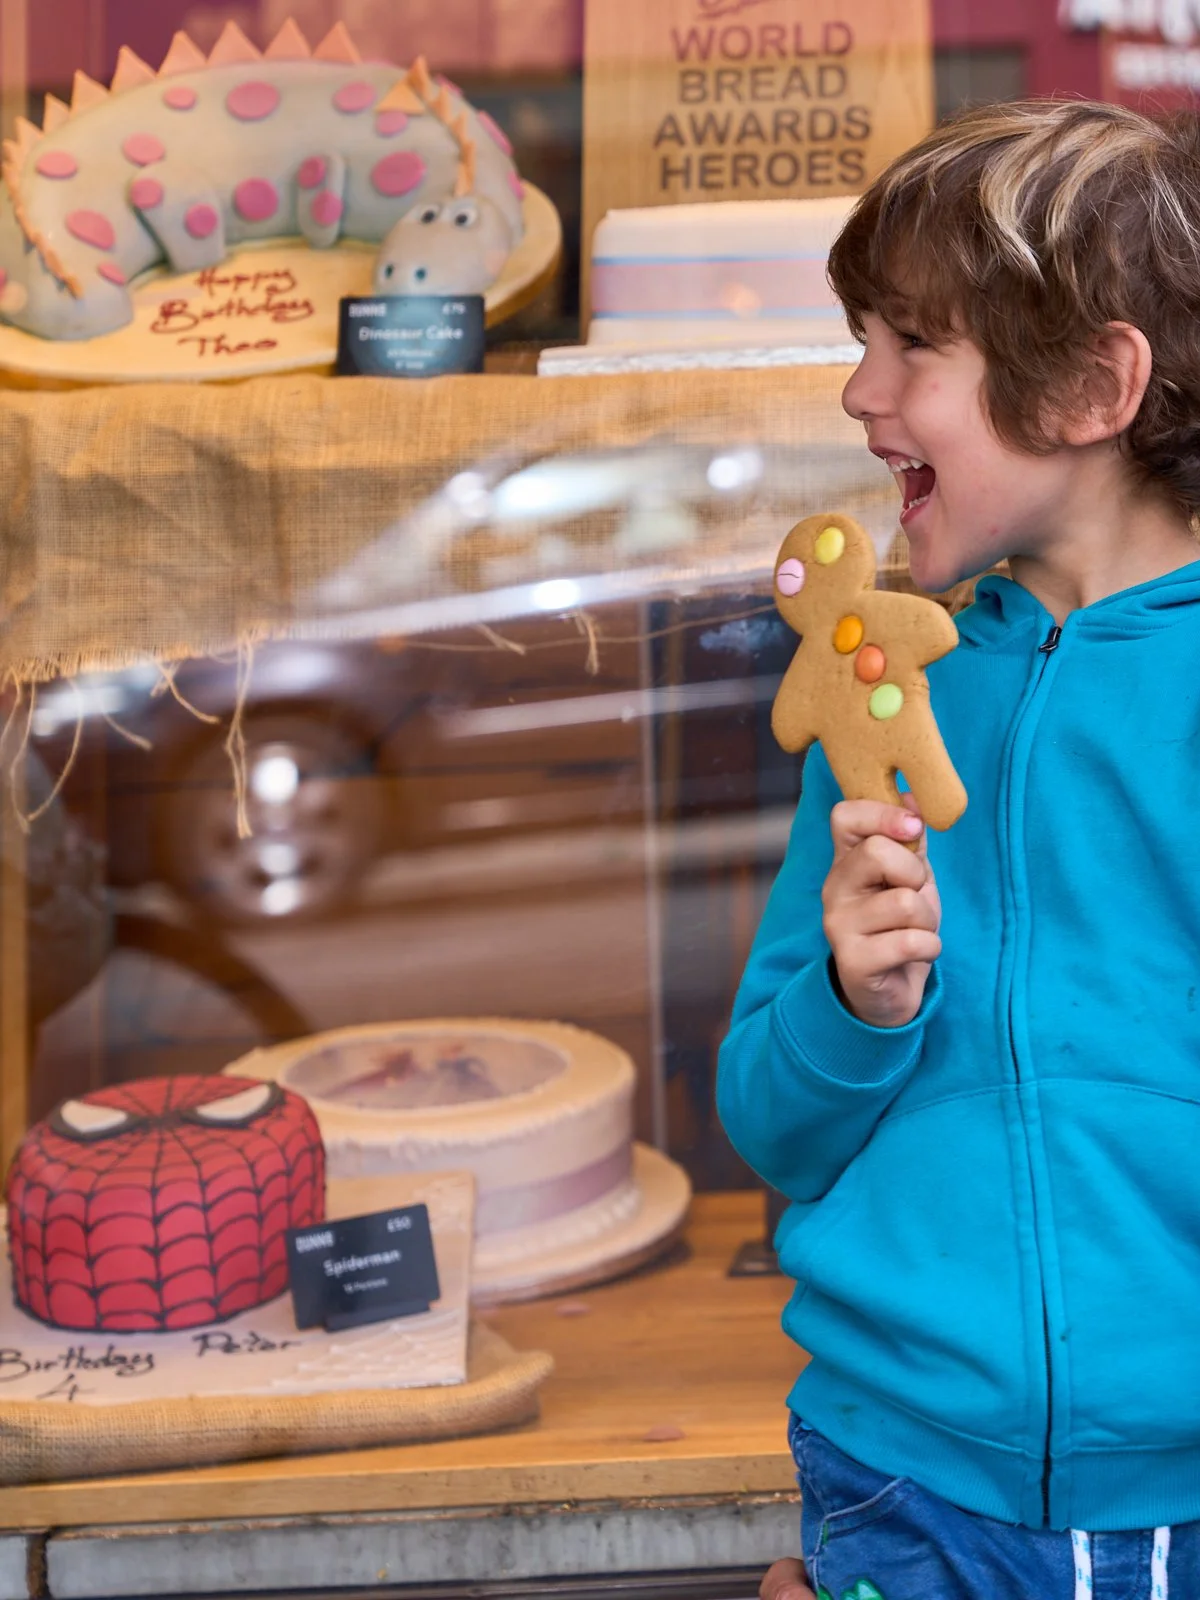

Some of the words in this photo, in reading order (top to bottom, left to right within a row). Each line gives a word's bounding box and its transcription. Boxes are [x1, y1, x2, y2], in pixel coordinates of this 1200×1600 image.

[670, 21, 853, 62] WORLD
[679, 64, 848, 103] BREAD
[653, 106, 872, 148] AWARDS
[660, 149, 866, 190] HEROES
[195, 268, 297, 298] Happy
[150, 297, 314, 334] Birthday
[358, 326, 423, 341] Dinosaur
[425, 324, 464, 340] Cake
[386, 1215, 412, 1233] £50
[323, 1249, 402, 1278] Spiderman
